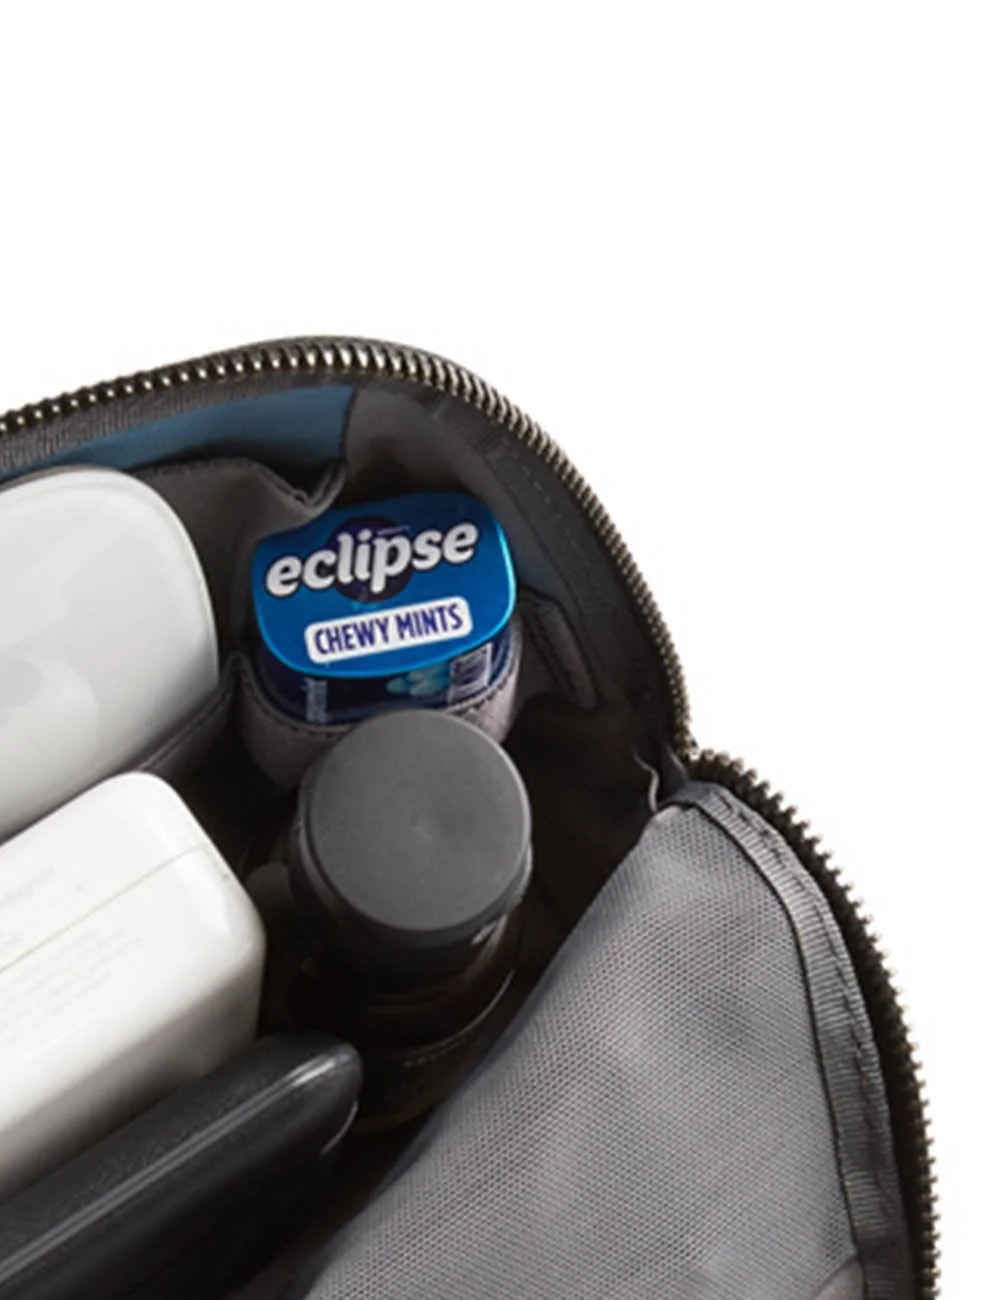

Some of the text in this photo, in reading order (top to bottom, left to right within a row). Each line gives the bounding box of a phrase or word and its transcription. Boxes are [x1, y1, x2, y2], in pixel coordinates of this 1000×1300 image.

[265, 522, 479, 597] eclipse
[313, 603, 464, 656] CHEWY MINTS
